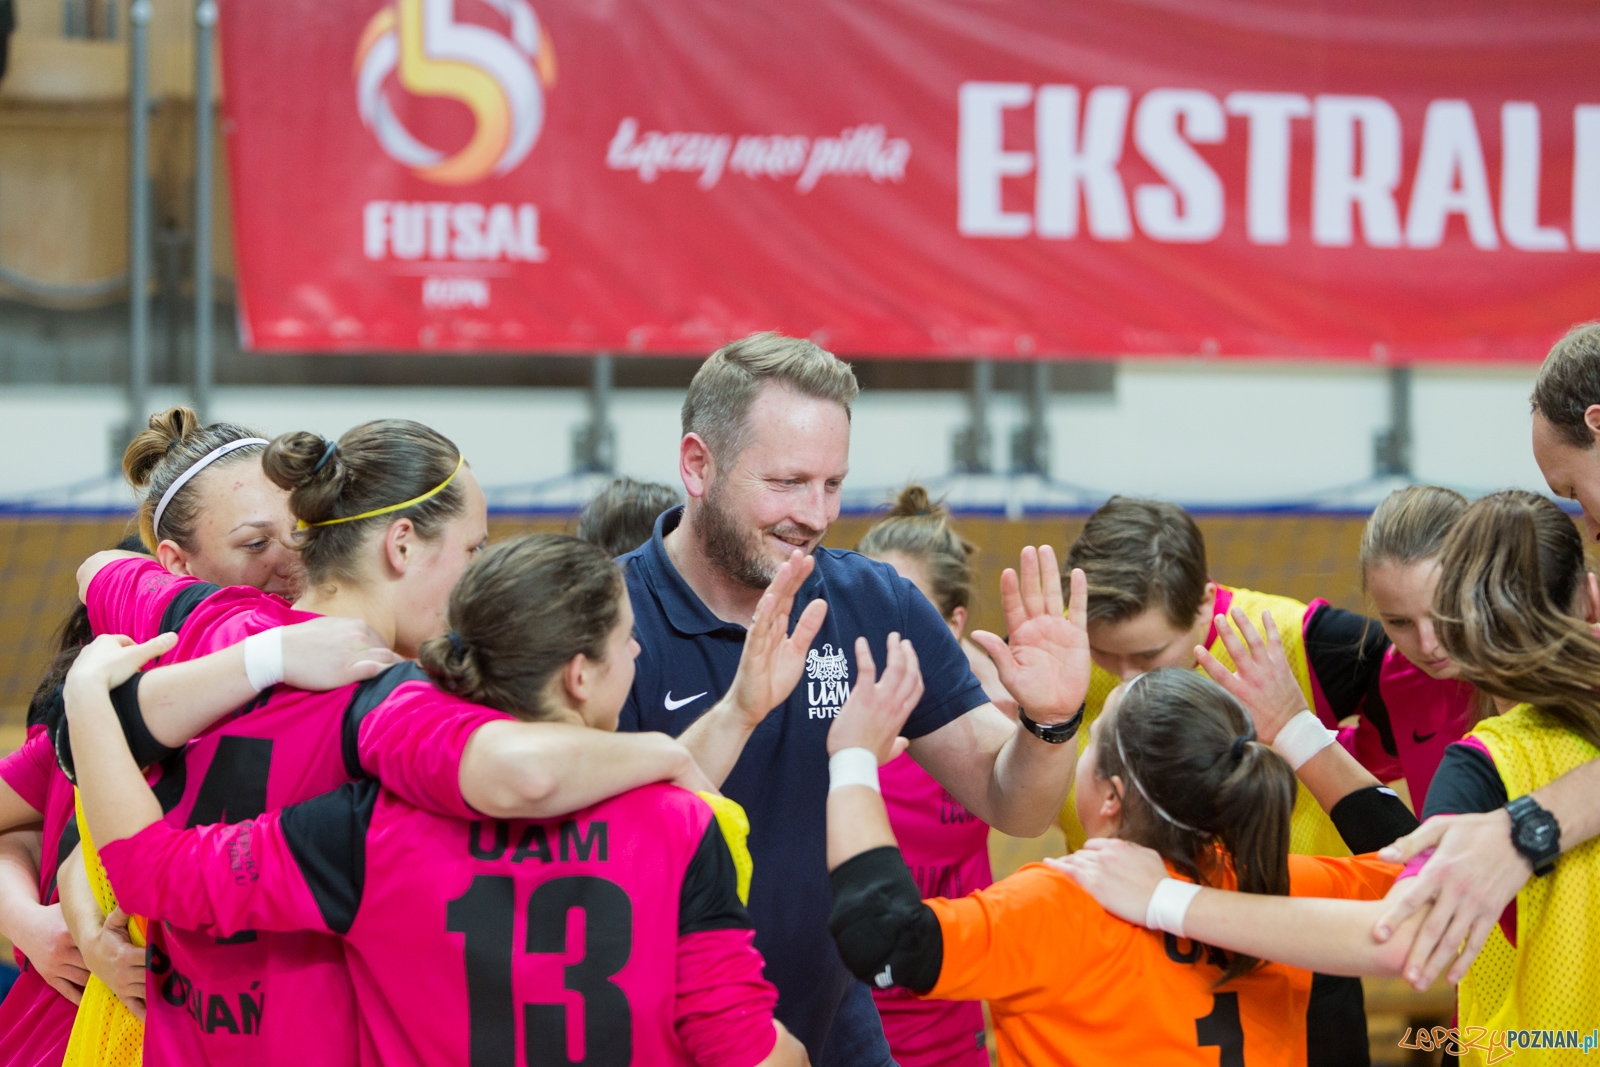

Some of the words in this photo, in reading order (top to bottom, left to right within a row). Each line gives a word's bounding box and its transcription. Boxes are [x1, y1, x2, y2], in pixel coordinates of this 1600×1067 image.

[606, 116, 733, 191] Łączy
[729, 133, 811, 181] nas
[795, 123, 911, 195] piłka
[363, 200, 549, 263] FUTSAL
[807, 681, 851, 706] UAM
[467, 819, 608, 864] UAM
[446, 873, 634, 1067] 13
